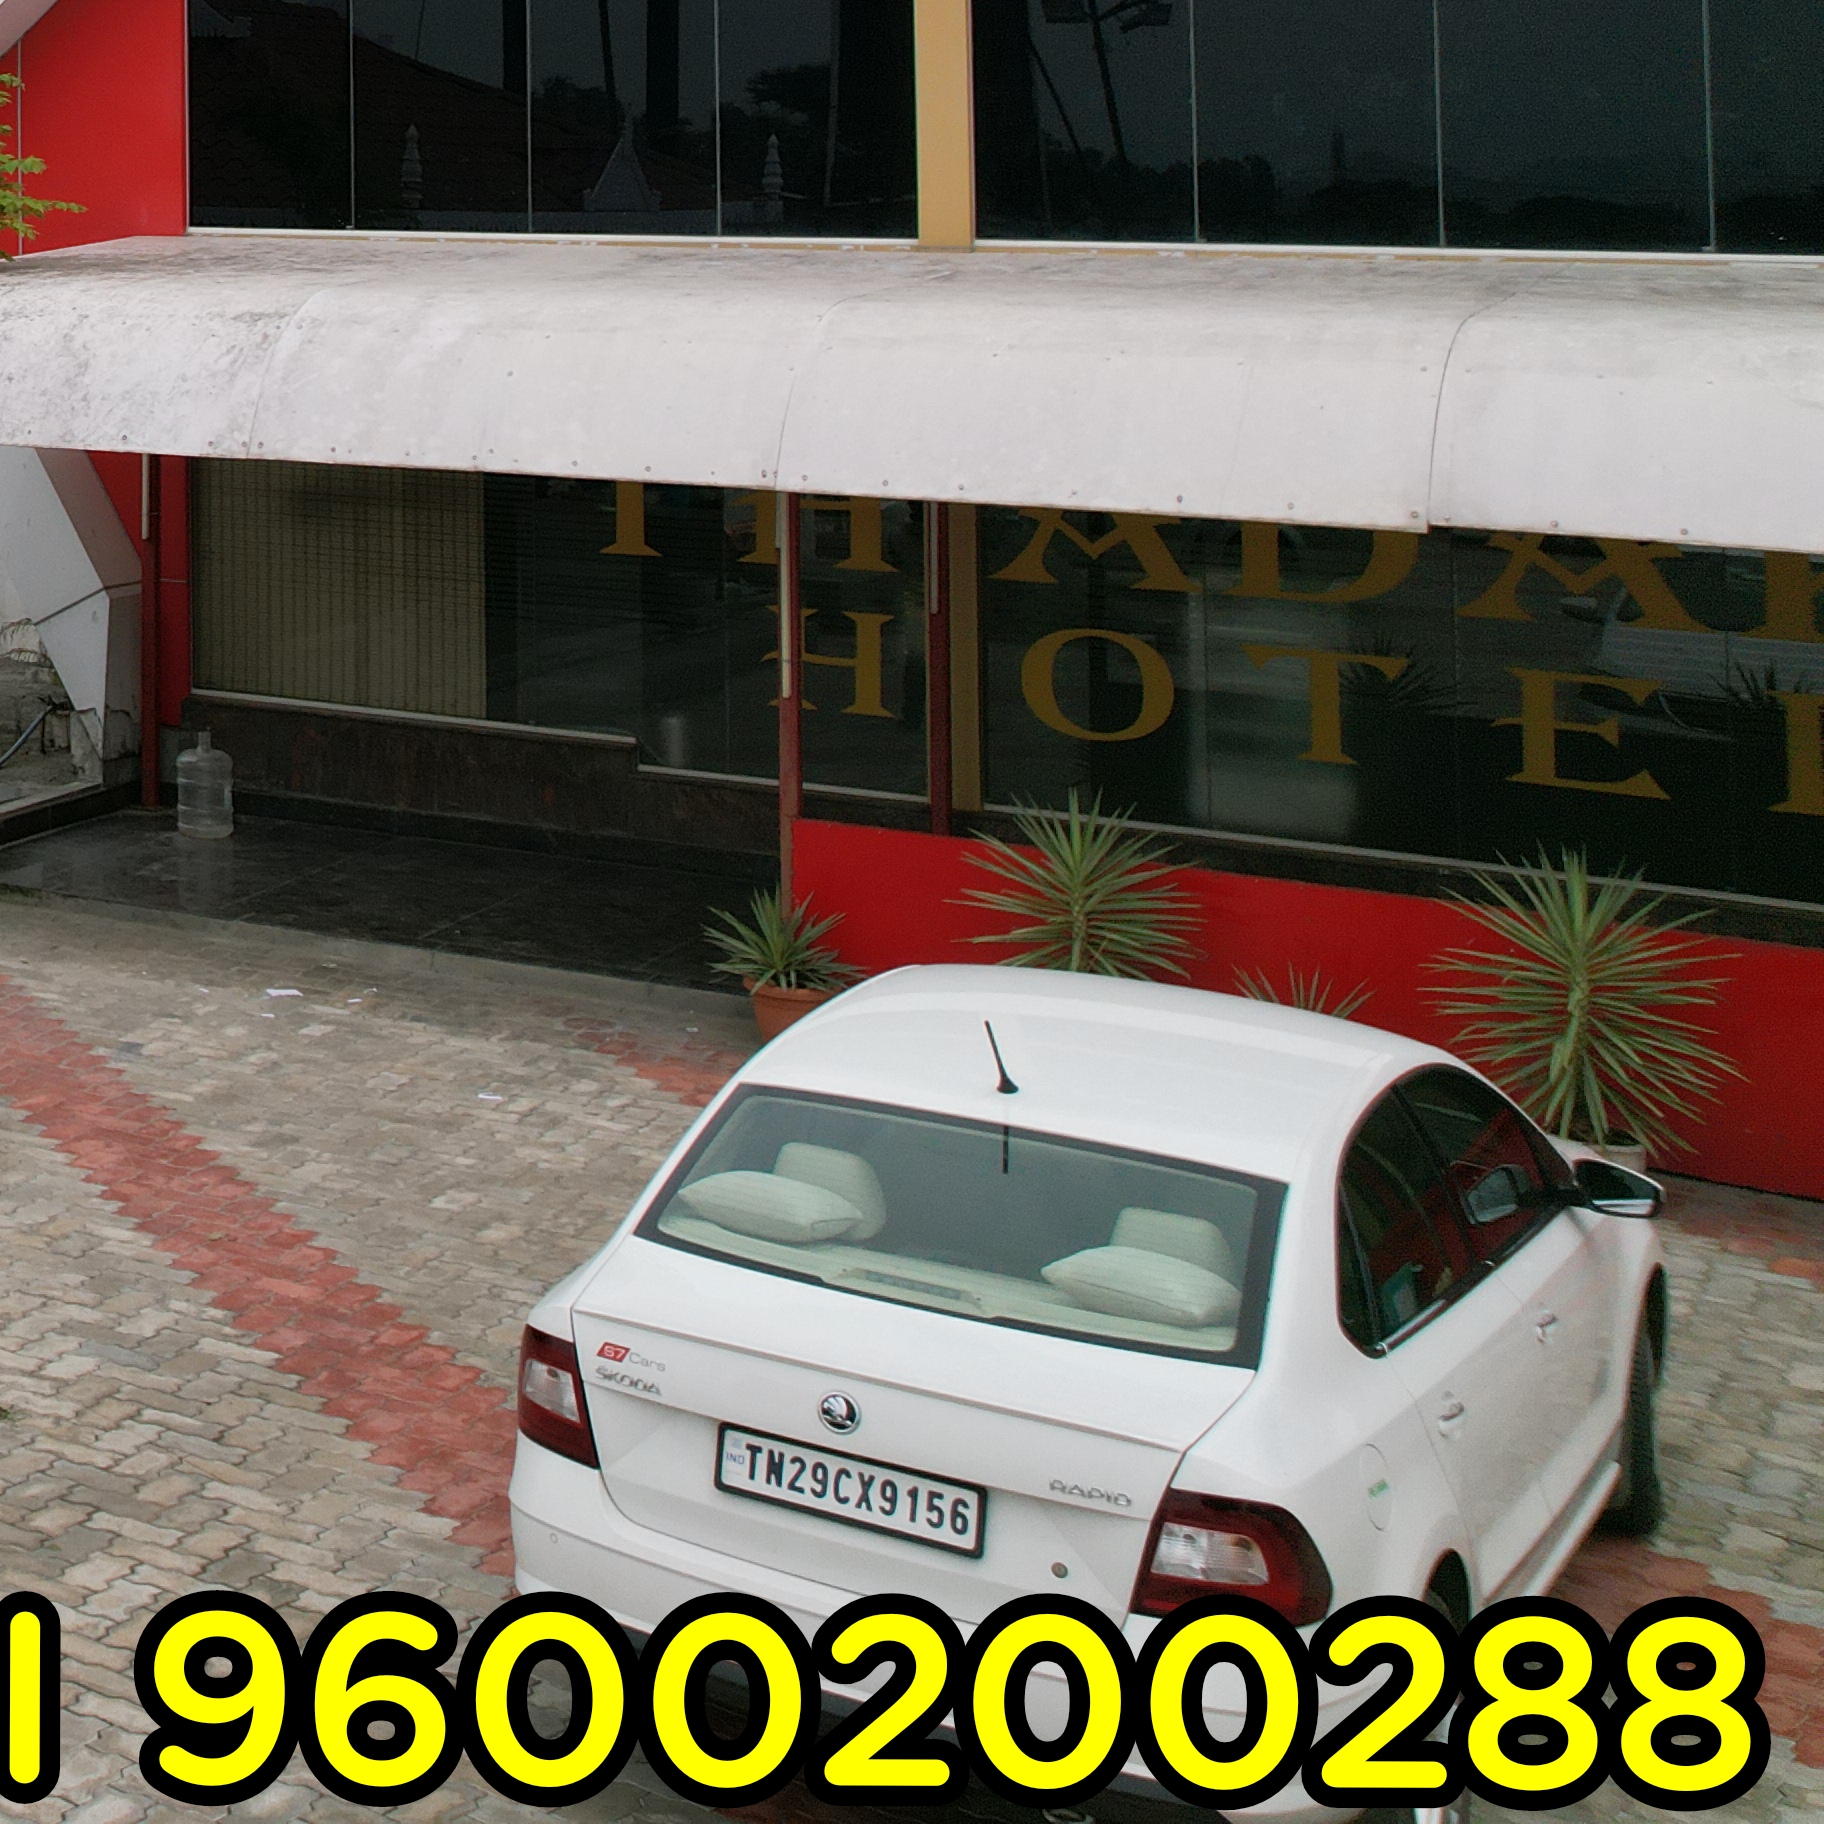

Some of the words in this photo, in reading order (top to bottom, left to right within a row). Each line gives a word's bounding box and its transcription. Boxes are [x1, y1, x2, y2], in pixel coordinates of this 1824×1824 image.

[628, 1351, 666, 1372] Cars
[725, 1451, 745, 1465] IND
[745, 1442, 971, 1536] TN29CX9156
[1048, 1479, 1132, 1507] RAPID
